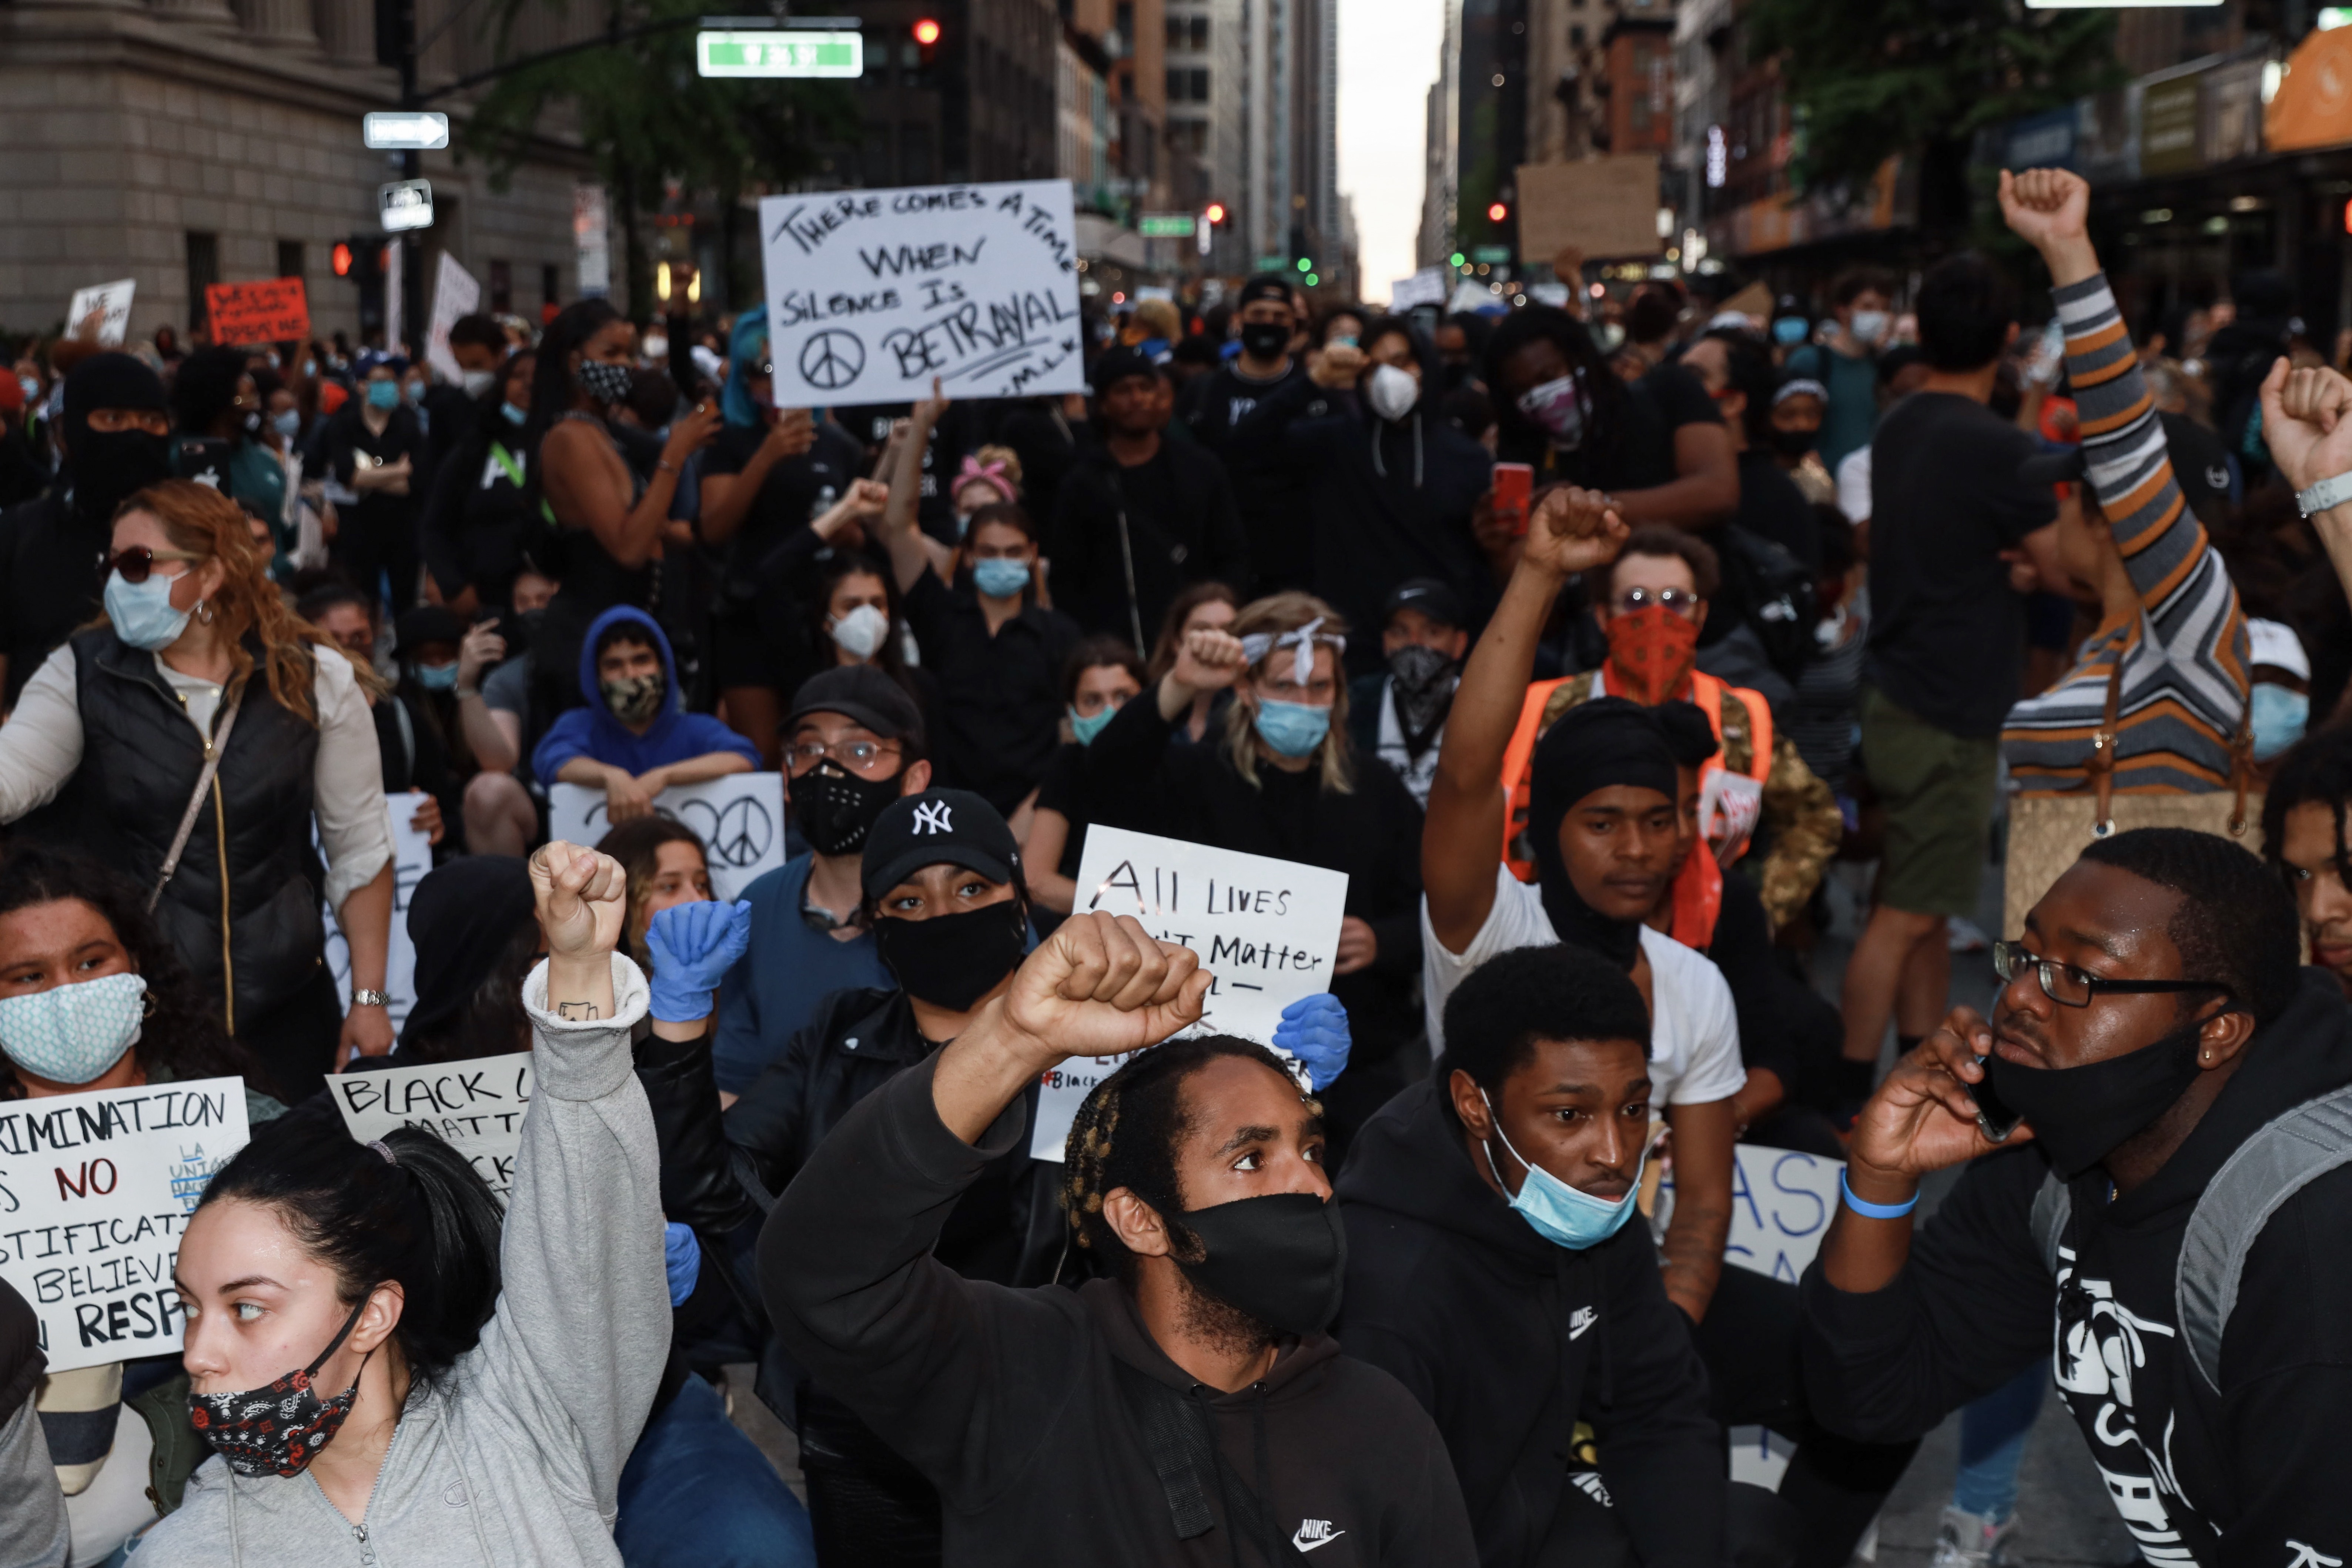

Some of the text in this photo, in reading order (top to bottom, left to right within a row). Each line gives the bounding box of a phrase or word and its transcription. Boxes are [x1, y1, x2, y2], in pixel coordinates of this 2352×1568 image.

[771, 189, 1073, 274] THERE COMES A TIME
[858, 235, 987, 278] WHEN
[880, 286, 1080, 380] BETRAYAL
[912, 799, 954, 836] NY
[1089, 859, 1292, 916] All LIVES
[1210, 934, 1323, 971] Matter
[342, 1072, 502, 1115] BLACK
[404, 1112, 526, 1141] MATT
[180, 1142, 205, 1159] LA
[54, 1159, 117, 1201] NO
[75, 1288, 181, 1347] RESP
[1299, 1519, 1332, 1539] NIKE
